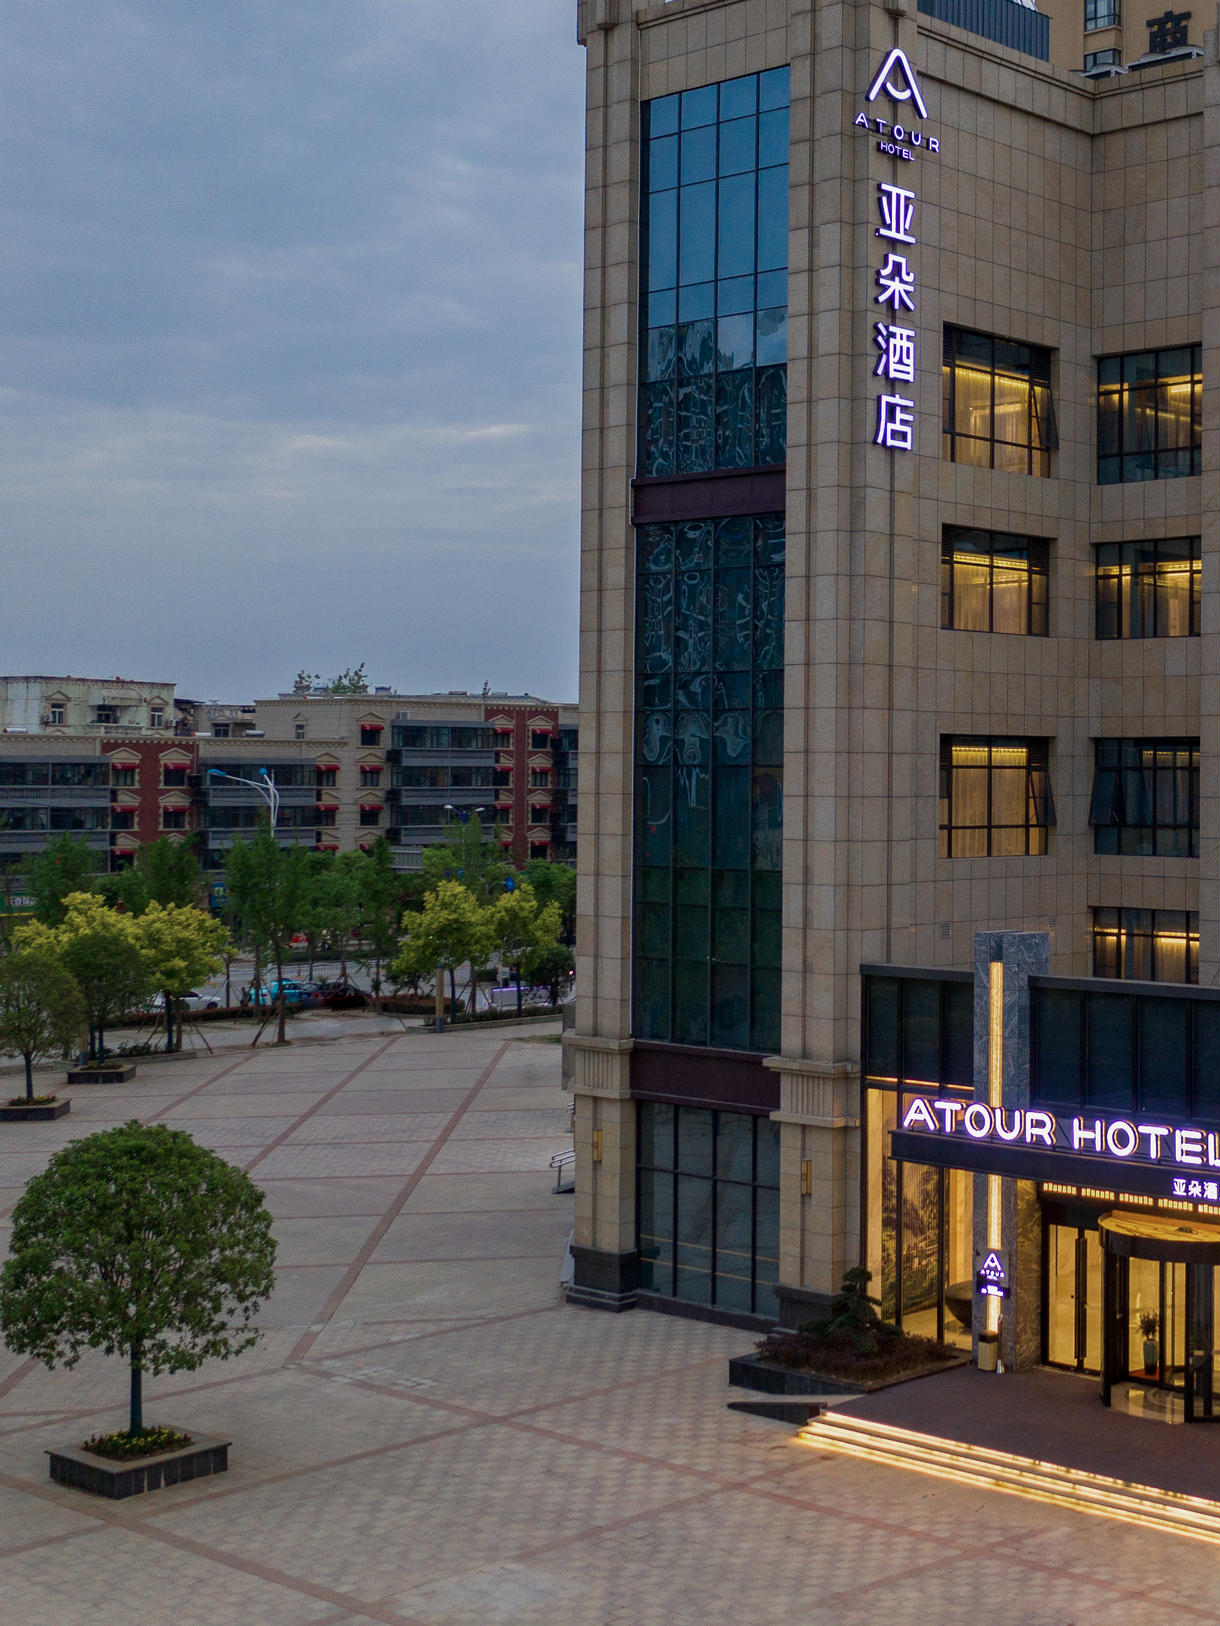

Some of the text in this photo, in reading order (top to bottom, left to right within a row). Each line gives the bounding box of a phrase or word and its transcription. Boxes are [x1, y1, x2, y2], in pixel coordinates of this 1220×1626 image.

[854, 112, 940, 153] ATOUR
[880, 141, 916, 161] HOTEL
[875, 182, 917, 451] 亚朵酒店
[902, 1096, 1057, 1145] ATOUR
